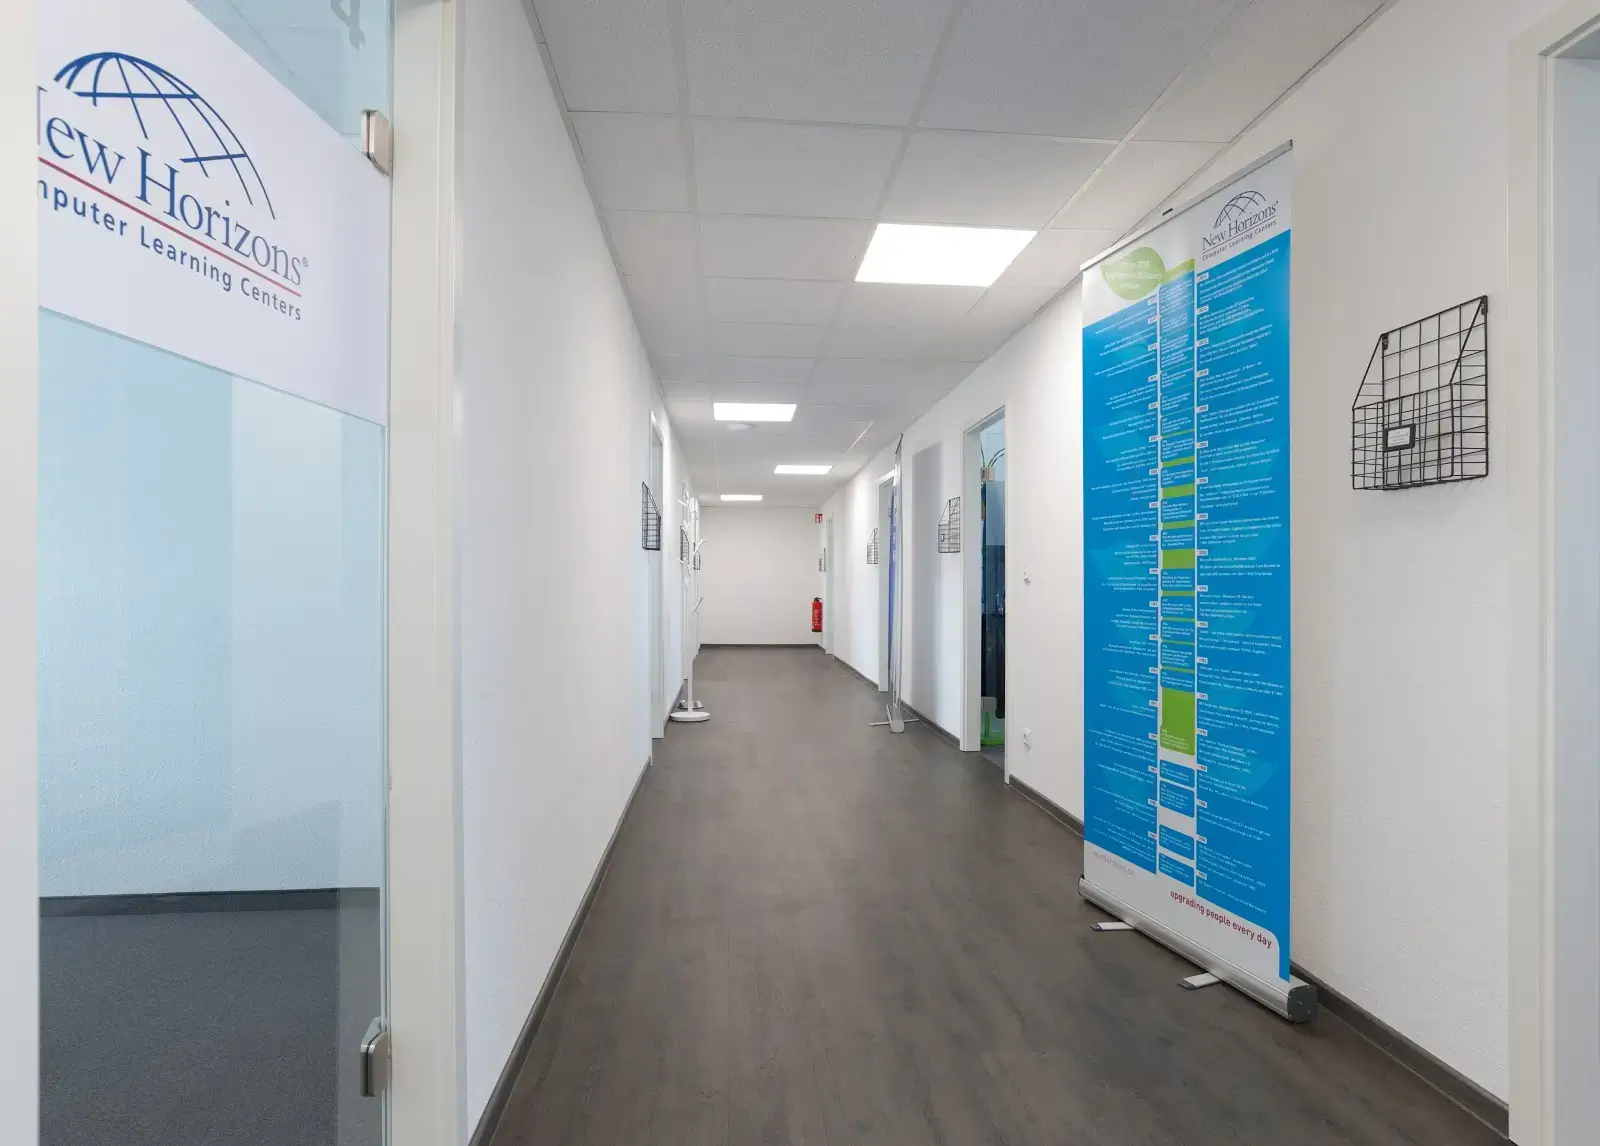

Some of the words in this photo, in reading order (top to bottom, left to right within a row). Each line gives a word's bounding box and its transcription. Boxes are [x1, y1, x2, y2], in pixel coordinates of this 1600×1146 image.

[1202, 245, 1228, 261] Computer
[1229, 232, 1253, 248] Learning
[1254, 220, 1277, 235] Centers
[1202, 233, 1226, 251] New
[141, 225, 231, 292] Learning
[241, 277, 301, 320] Centers
[1170, 890, 1205, 915] upgrading
[1206, 908, 1231, 927] people
[1232, 921, 1255, 940] every
[1256, 933, 1272, 948] day
